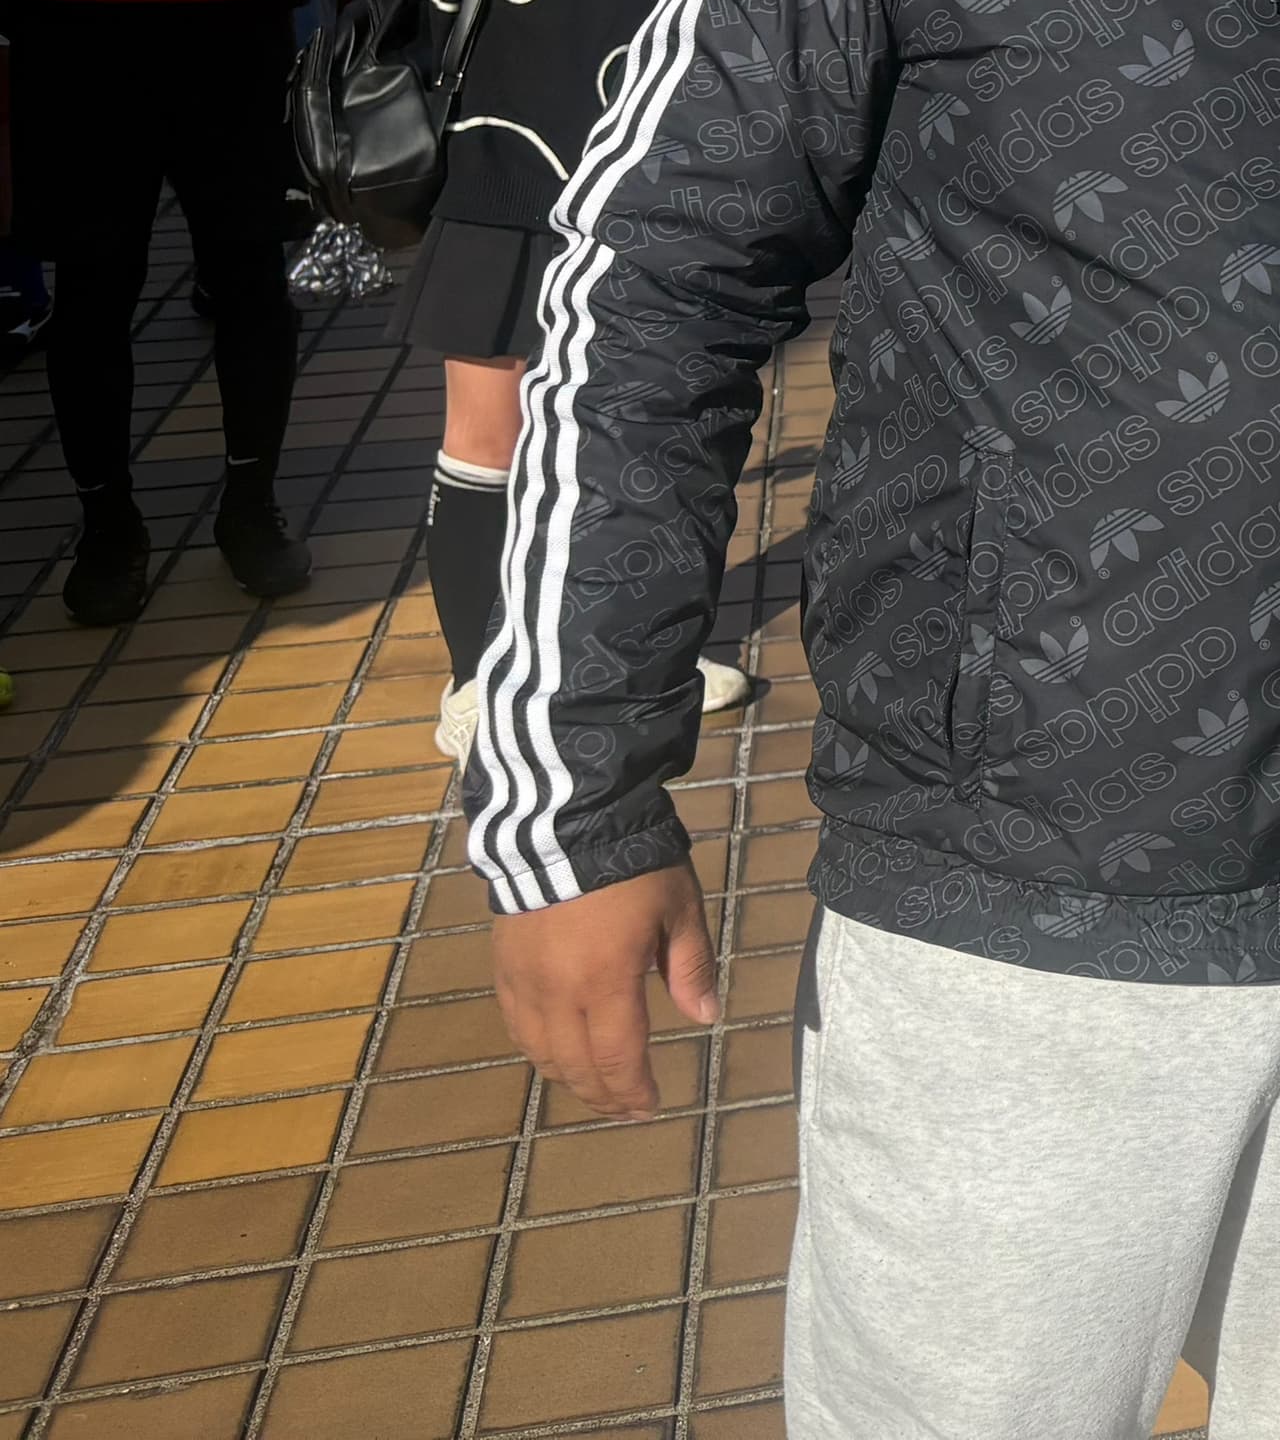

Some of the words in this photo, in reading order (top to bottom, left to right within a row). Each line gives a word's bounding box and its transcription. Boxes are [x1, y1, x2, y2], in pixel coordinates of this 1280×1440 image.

[938, 78, 1125, 227] adidas
[1012, 286, 1209, 436] adidas
[1014, 626, 1237, 769] adidas
